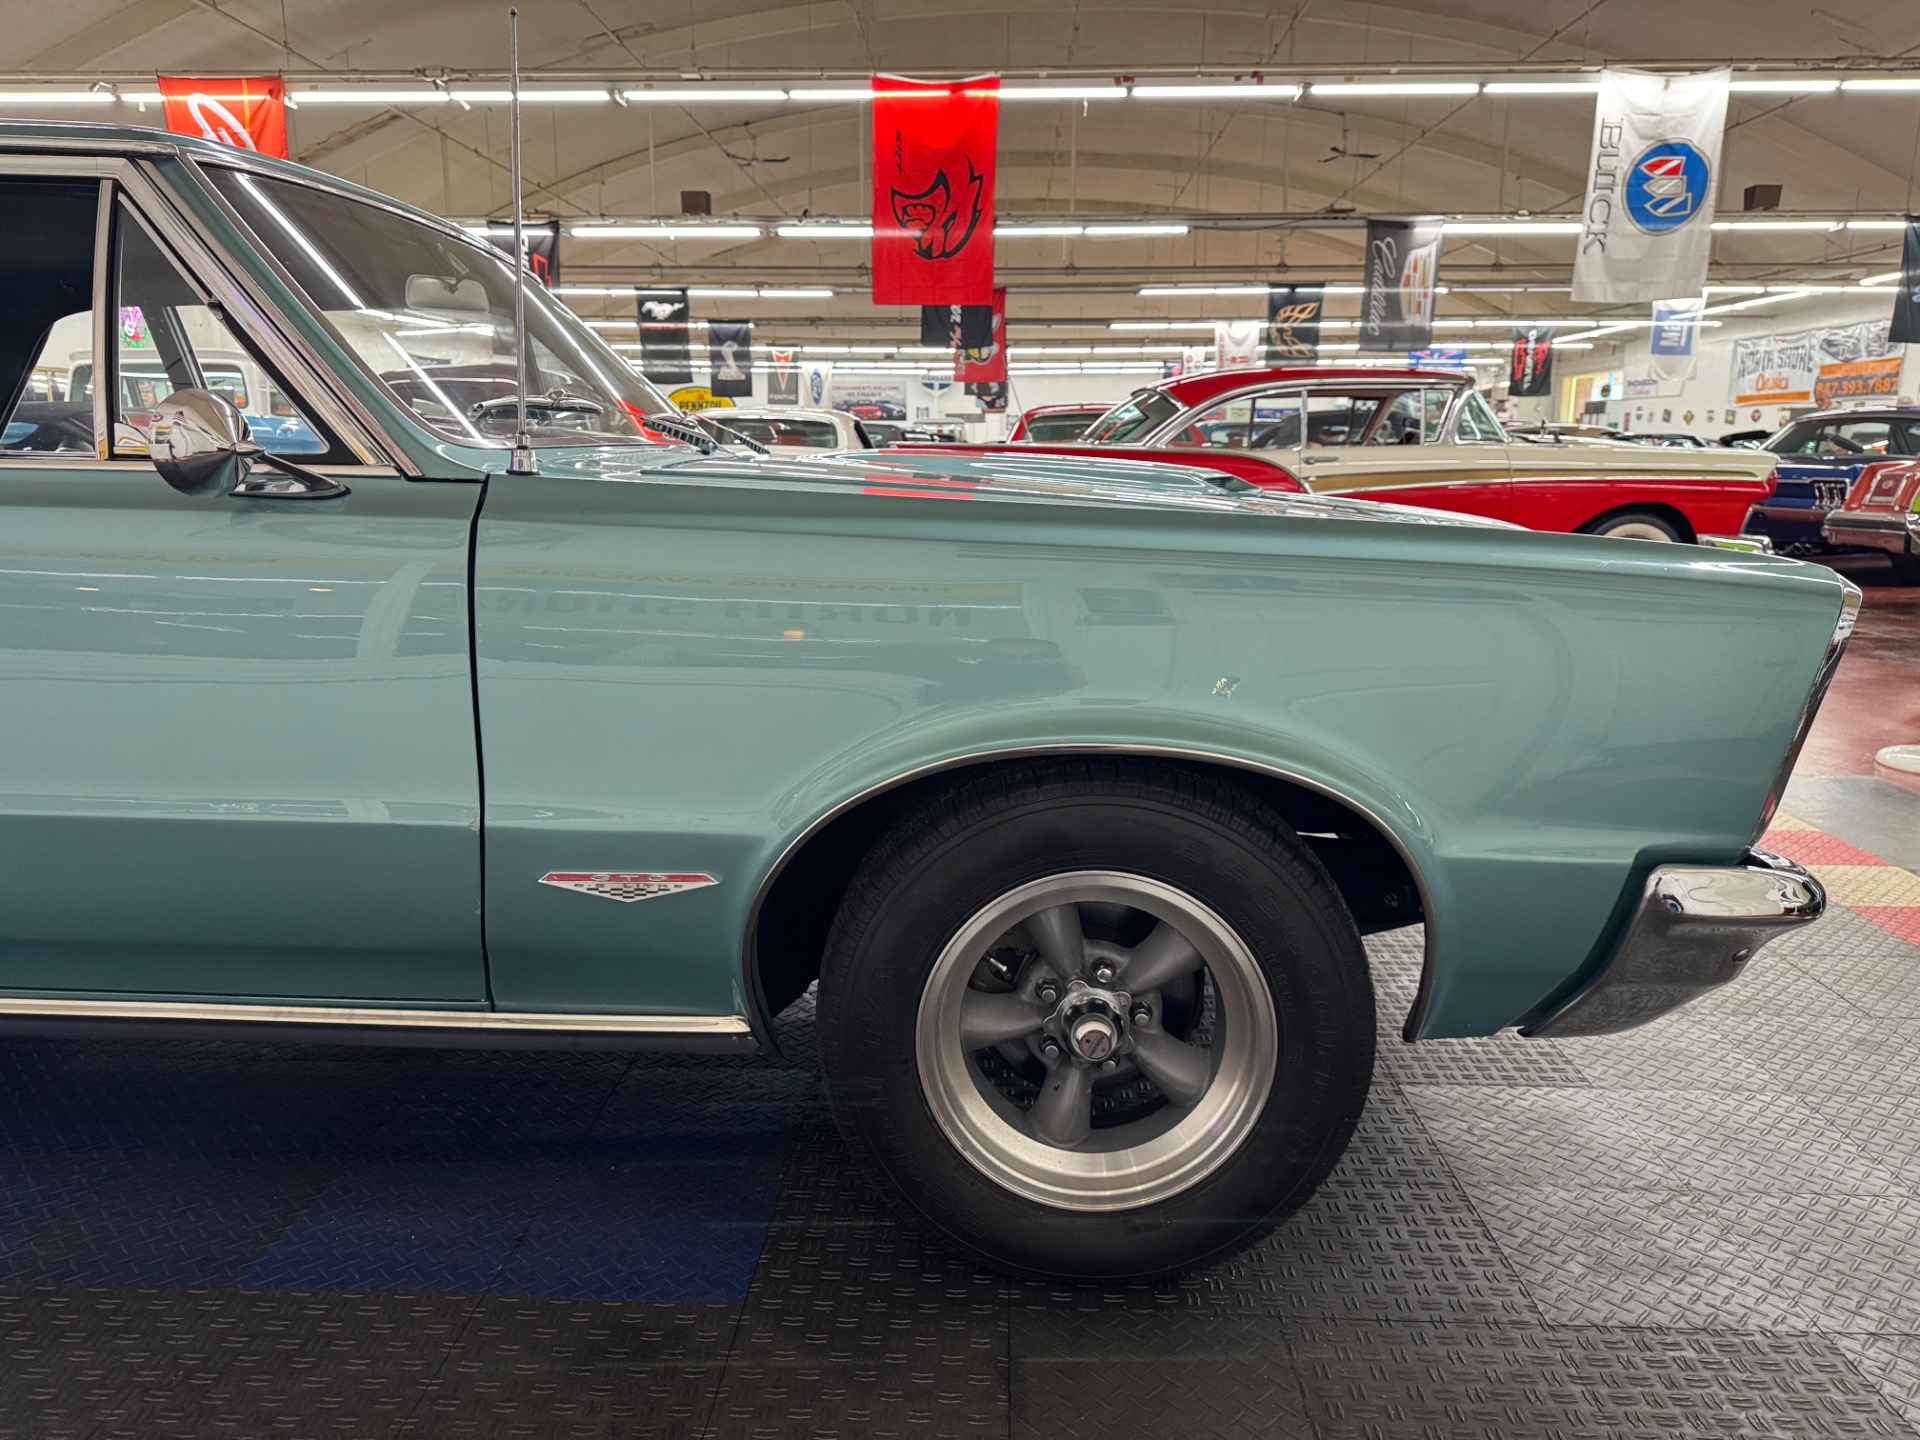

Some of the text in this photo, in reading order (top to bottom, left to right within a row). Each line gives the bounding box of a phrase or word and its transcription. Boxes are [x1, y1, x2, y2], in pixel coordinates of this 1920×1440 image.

[894, 128, 903, 175] SRT
[1583, 117, 1624, 255] BUICK
[1367, 237, 1397, 337] Cadillac
[1777, 344, 1813, 373] SHORE
[590, 874, 667, 882] GTO
